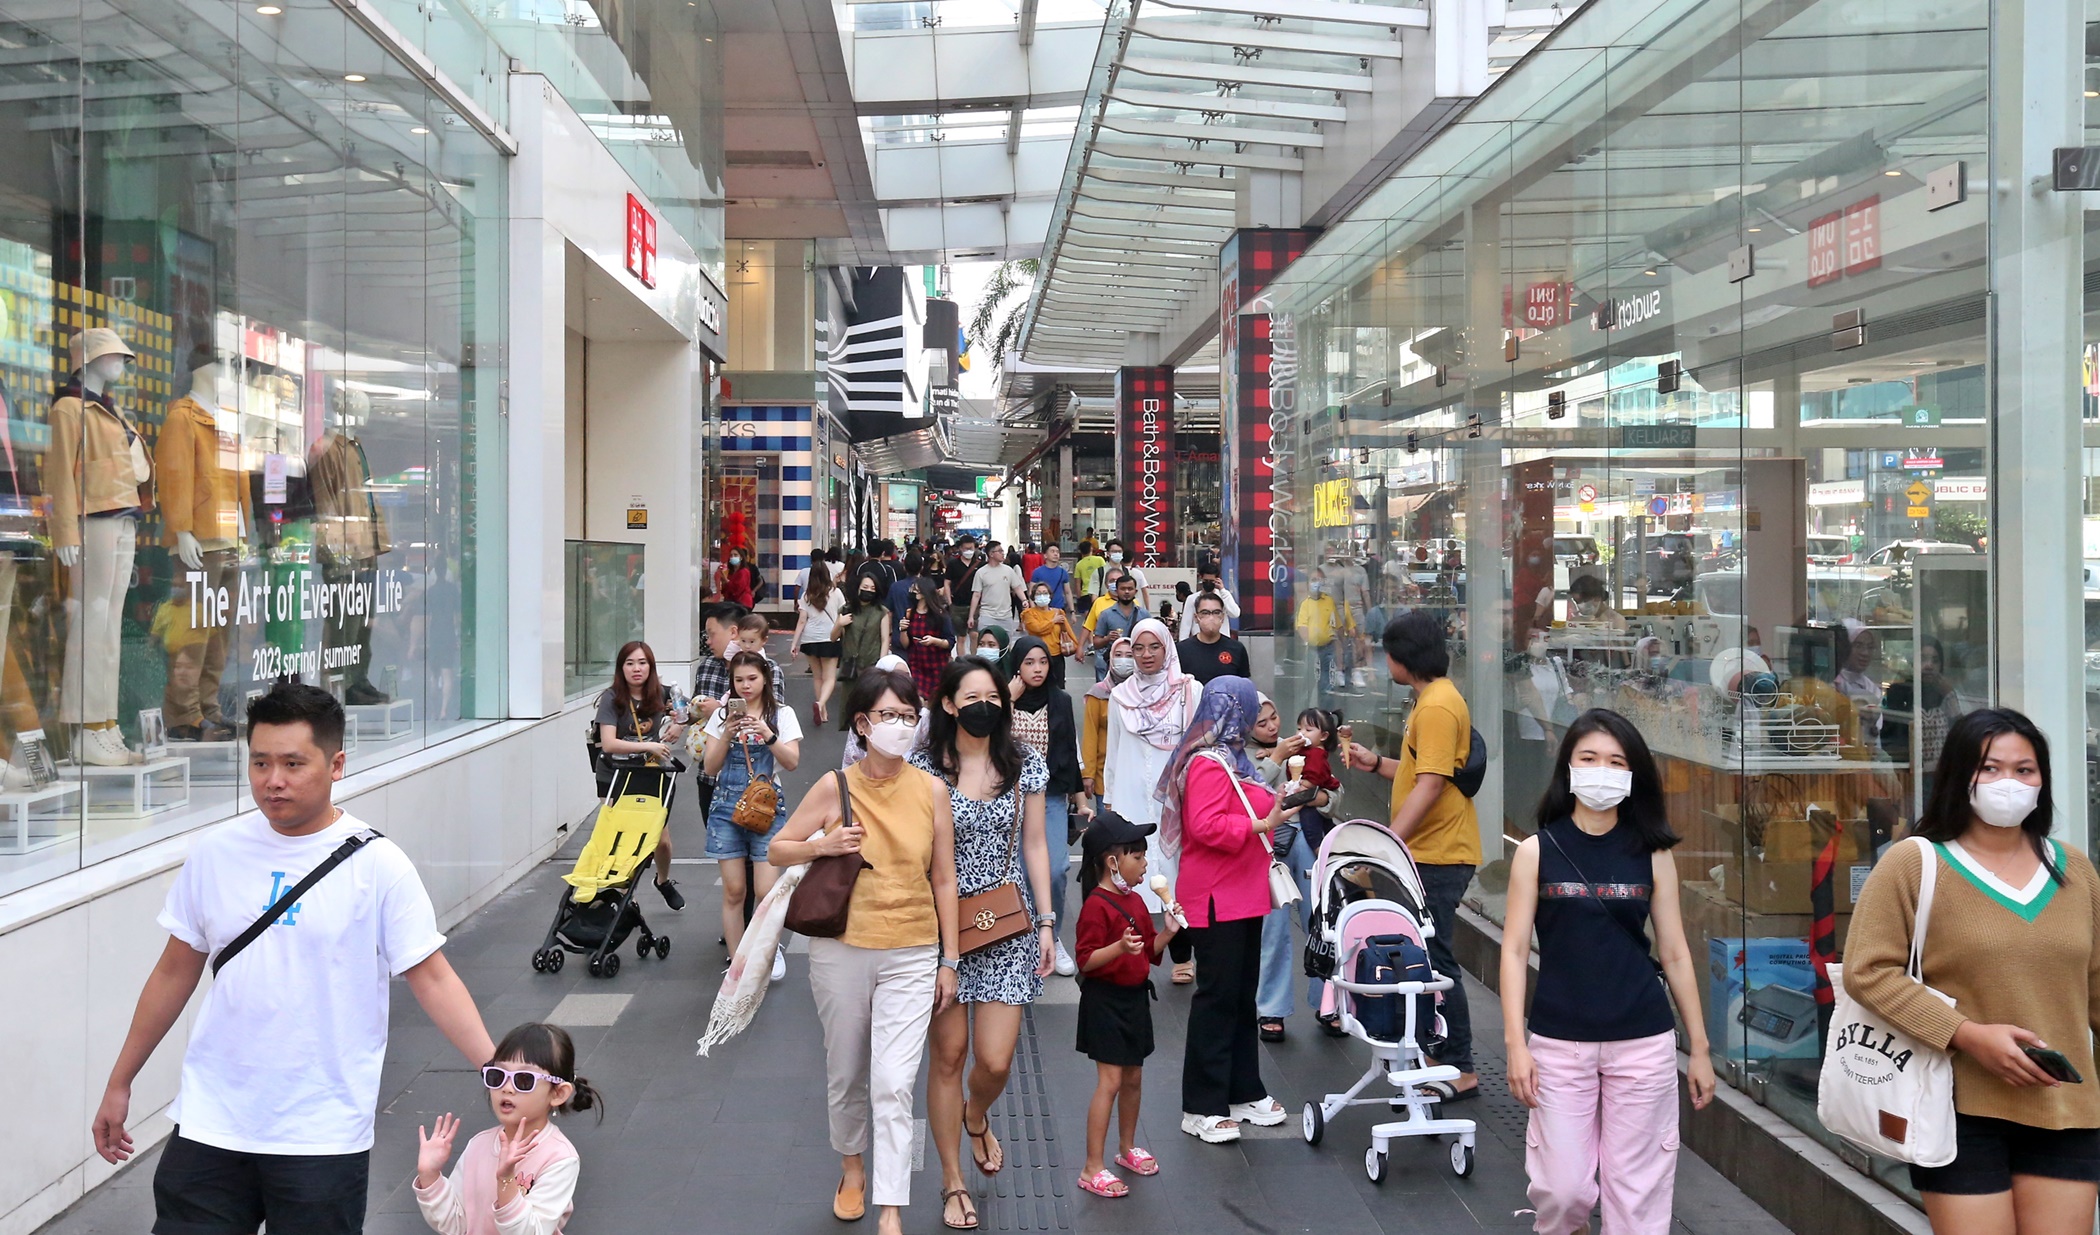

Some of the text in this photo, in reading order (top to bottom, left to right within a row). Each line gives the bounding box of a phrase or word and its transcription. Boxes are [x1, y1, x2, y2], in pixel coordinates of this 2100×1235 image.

[1628, 431, 1679, 445] KELUAR
[186, 569, 402, 629] The Art of Everyday Life
[252, 646, 282, 682] 2023
[283, 644, 316, 684] spring
[323, 643, 362, 670] summer
[1597, 886, 1644, 897] PARIS
[1836, 1022, 1914, 1072] BYLLA
